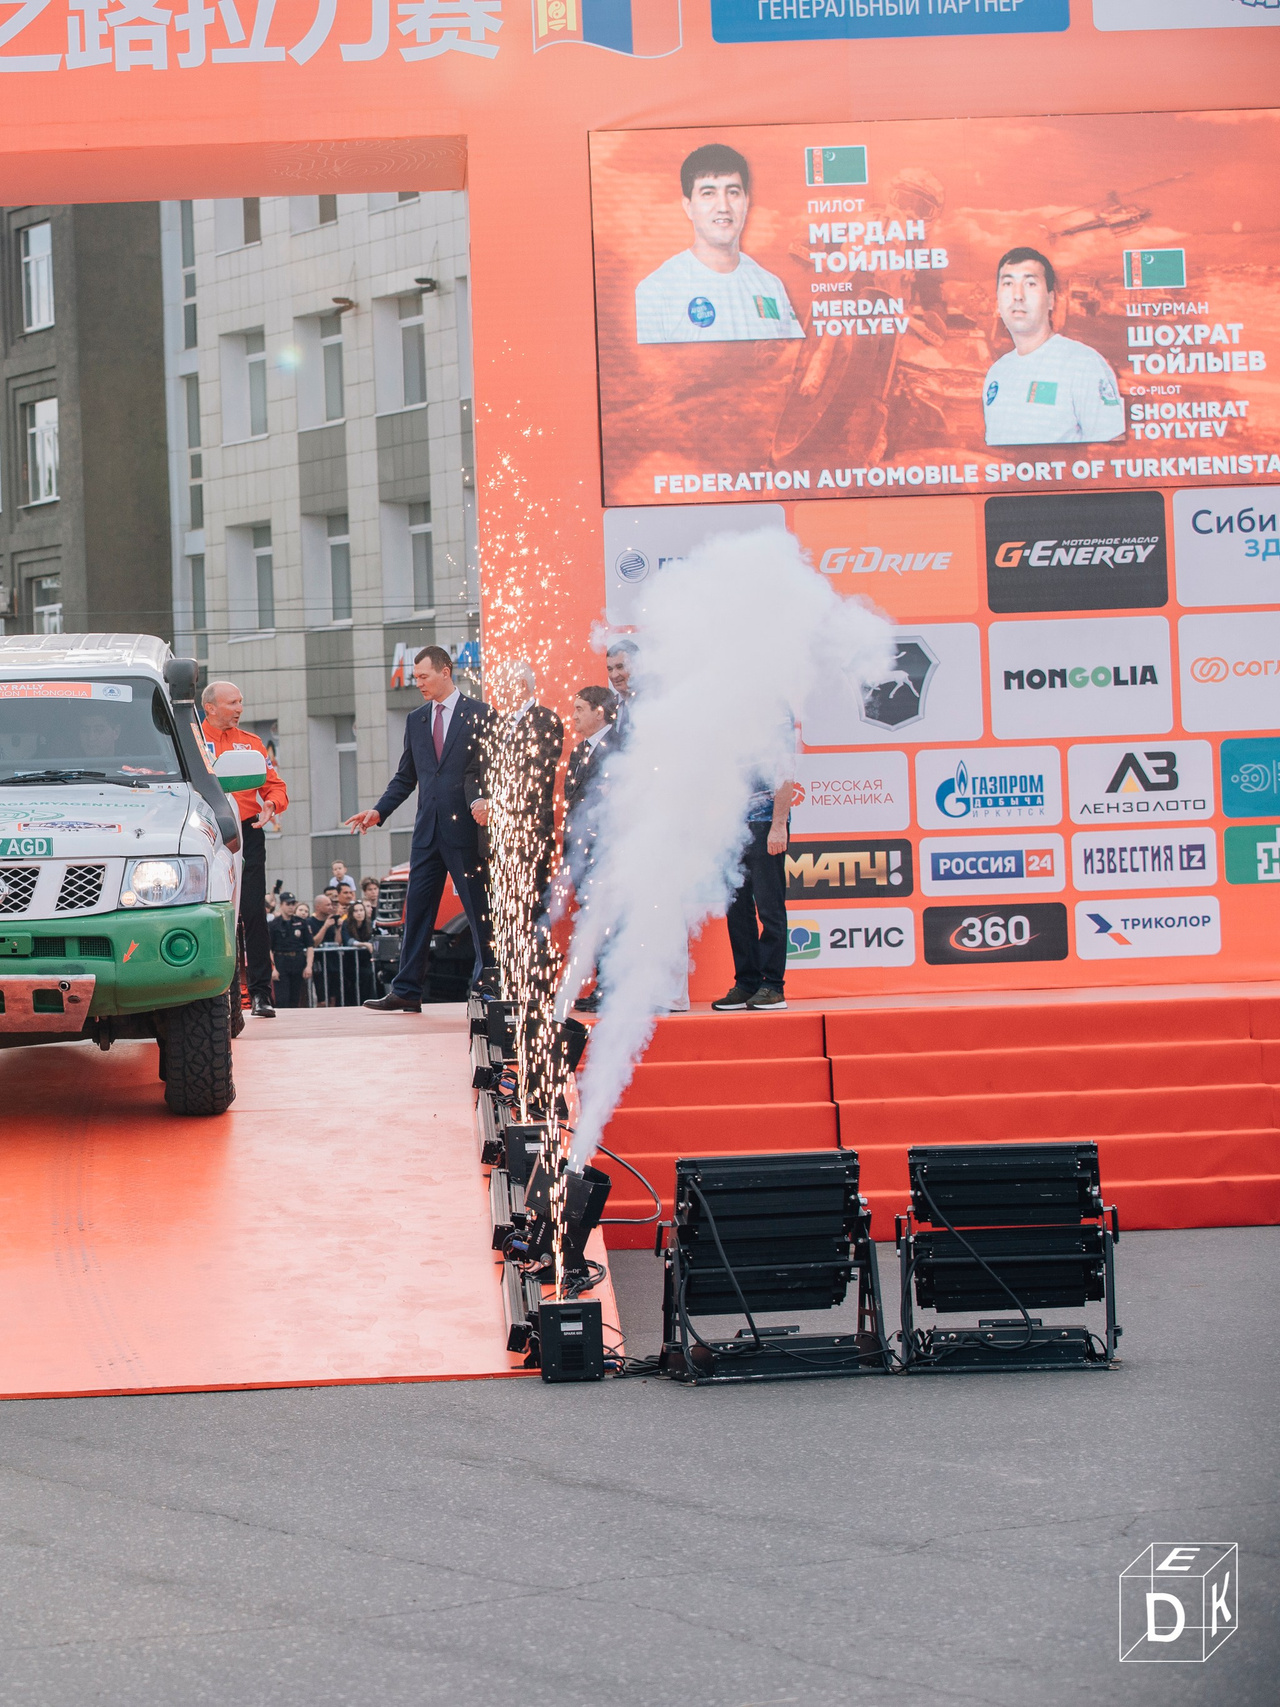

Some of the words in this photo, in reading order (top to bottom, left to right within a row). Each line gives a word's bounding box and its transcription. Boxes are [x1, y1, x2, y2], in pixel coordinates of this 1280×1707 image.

[757, 0, 919, 20] ГЕНЕРАЛЬНЫЙ
[807, 198, 865, 214] ПИЛОТ
[809, 219, 926, 246] МЕРДАН
[809, 246, 949, 273] ТОЙЛЫЕВ
[811, 282, 853, 293] DRIVER
[812, 298, 905, 318] MERDAN
[1126, 301, 1209, 317] ШТУРМАН
[812, 317, 910, 337] TOYLYEV
[1127, 322, 1244, 348] ШОХРАТ
[1127, 347, 1267, 375] ТОЙЛЫЕВ
[1129, 385, 1182, 396] CO-PILOT
[1130, 400, 1250, 421] SHOKHRAT
[1130, 420, 1228, 440] TOYLYEV
[654, 469, 810, 494] FEDERATION
[817, 463, 979, 489] AUTOMOBILE
[985, 461, 1066, 482] SPORT
[1071, 459, 1106, 480] OF
[1110, 454, 1280, 478] TURKMENISTA
[1191, 507, 1276, 535] Сиби
[1061, 537, 1121, 547] МОТОРНОЕ
[1122, 536, 1159, 544] МАСЛО
[1003, 664, 1159, 691] MONGOLIA
[33, 689, 88, 697] MONGOLIA
[810, 779, 883, 792] РУССКАЯ
[972, 773, 1044, 795] ГАЗПРОМ
[810, 792, 894, 806] МЕХАНИКА
[974, 796, 1043, 808] ДОБЫЧА
[1079, 799, 1206, 815] ЛЕНЗОЛОТО
[972, 807, 1045, 818] ИРКУТСК
[6, 838, 48, 855] AGD
[939, 856, 1016, 875] РОССИЯ
[1027, 854, 1052, 871] 24
[1083, 844, 1174, 875] ИЗВЕСТИЯ
[961, 914, 1031, 948] 360
[1120, 915, 1211, 930] ТРИКОЛОР
[829, 926, 905, 949] 2ГИС
